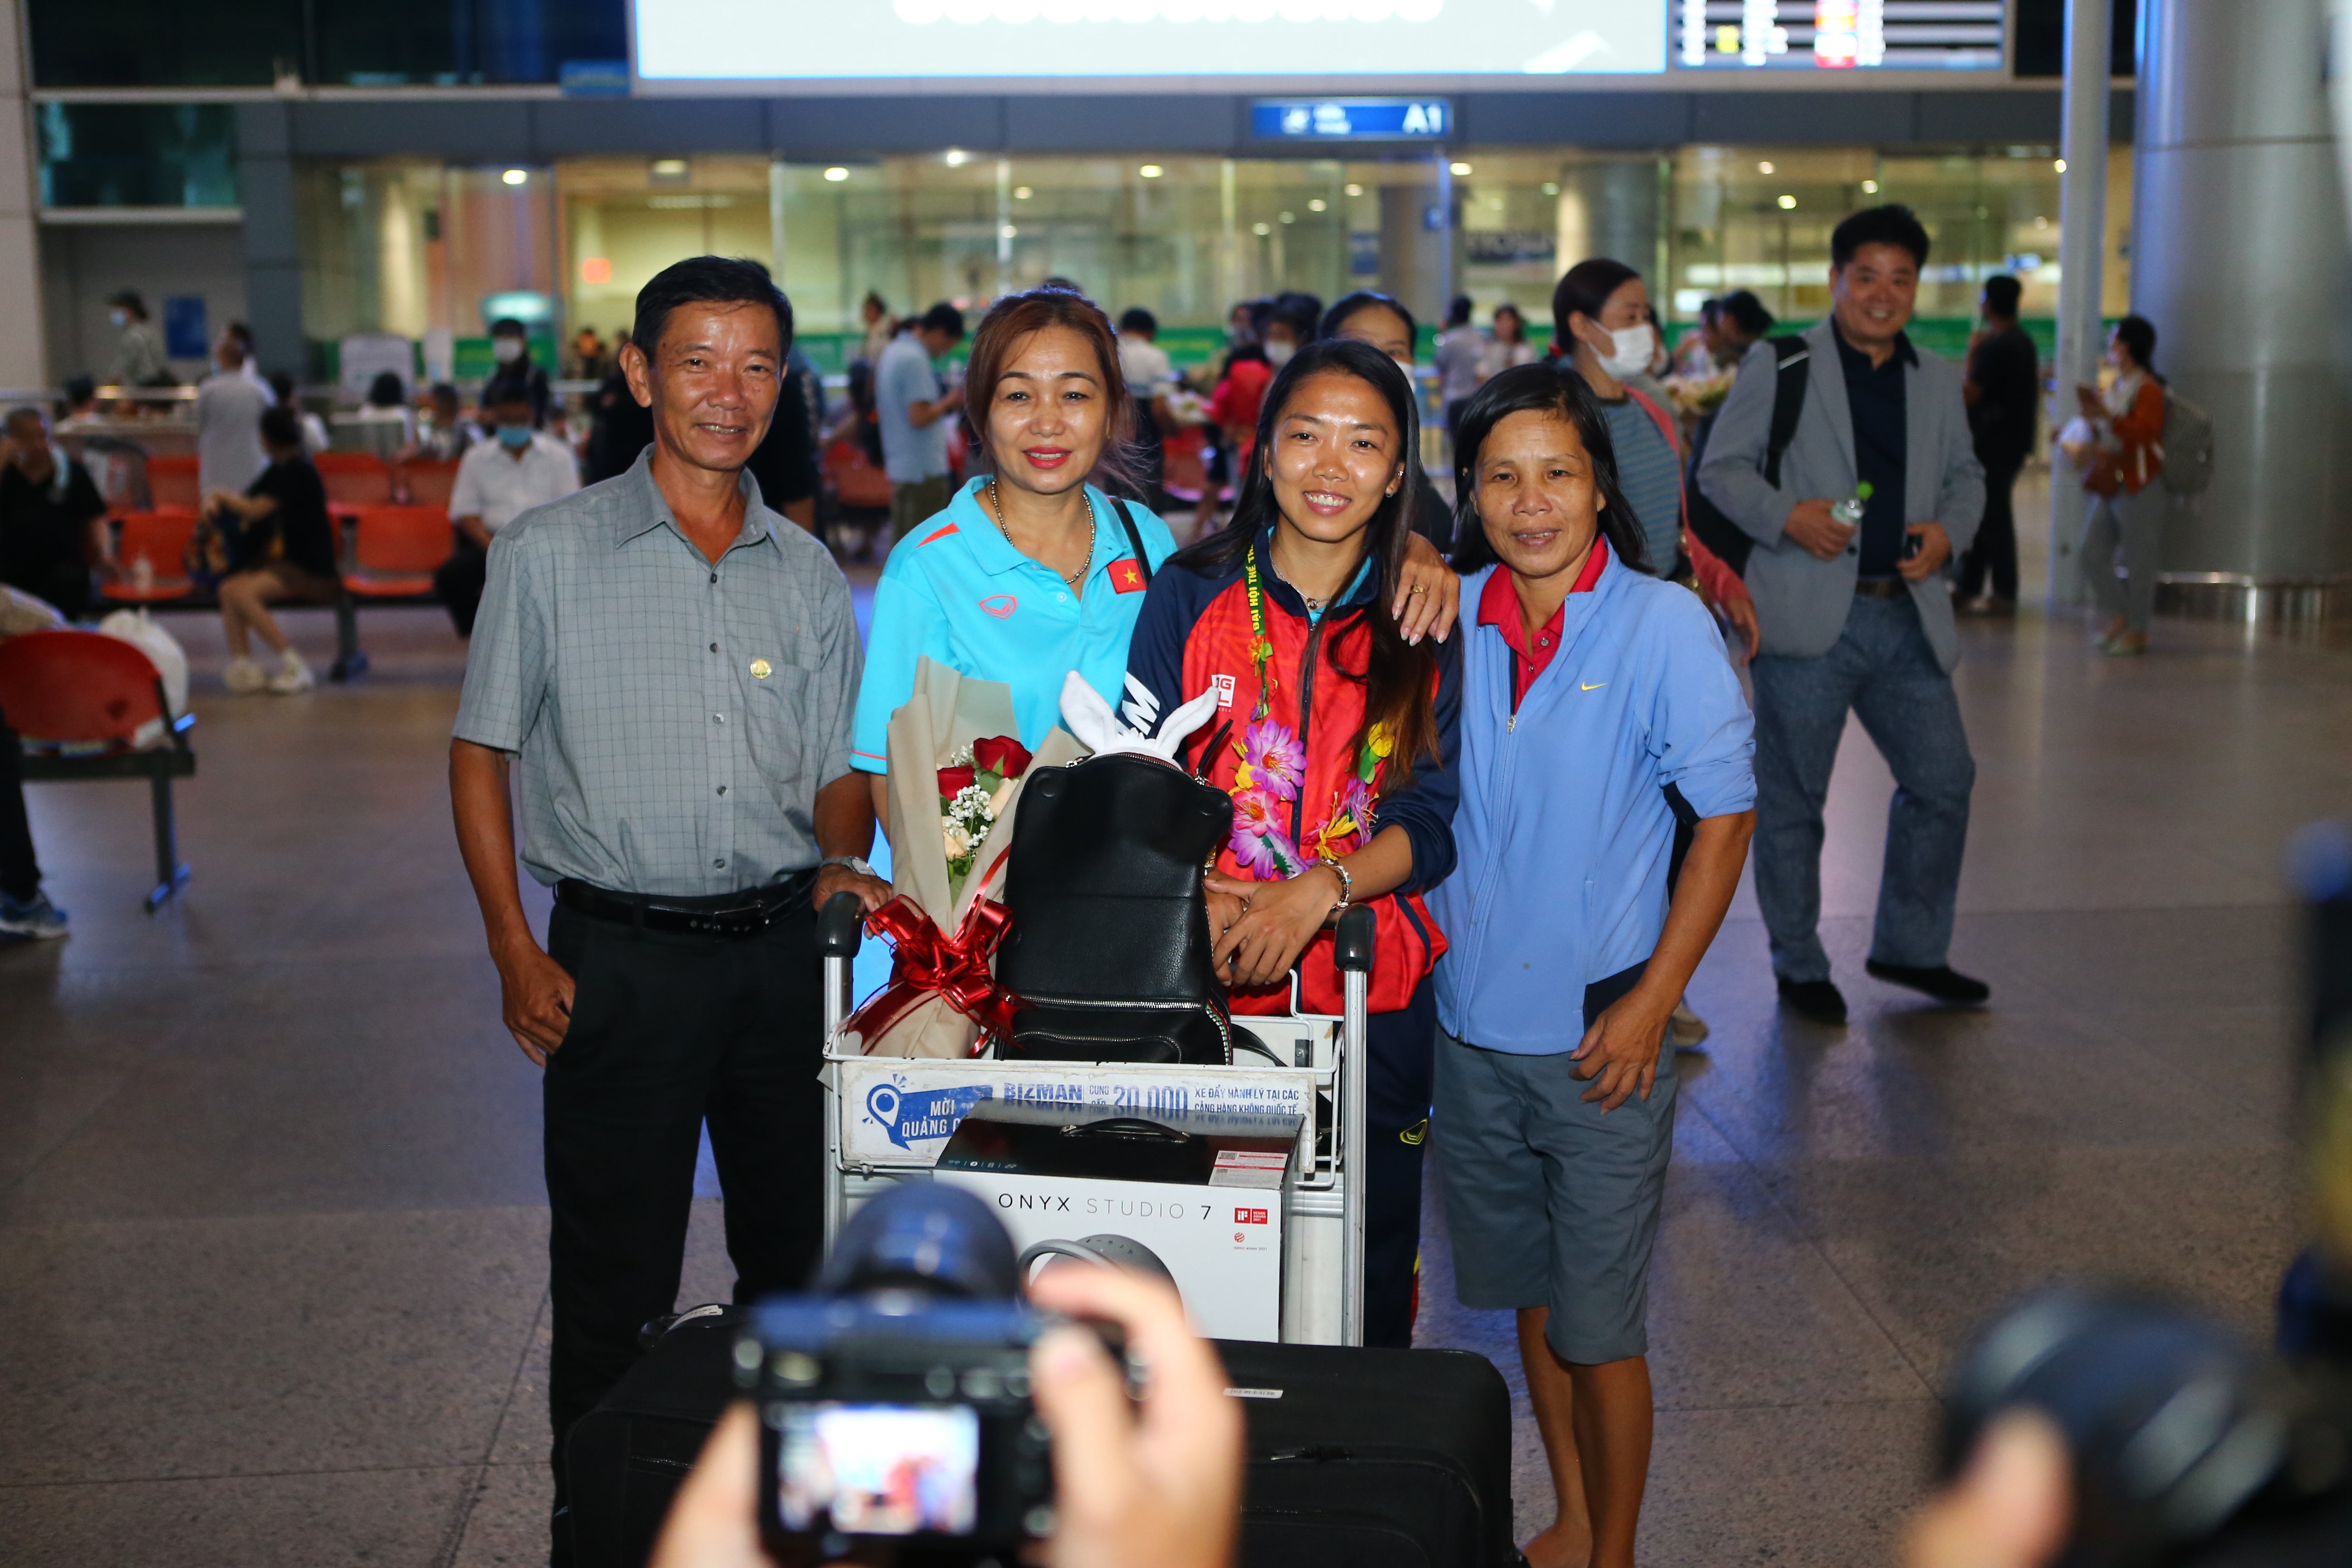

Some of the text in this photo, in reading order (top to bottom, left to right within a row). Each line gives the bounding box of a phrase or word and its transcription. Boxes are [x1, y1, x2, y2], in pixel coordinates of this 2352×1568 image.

[1402, 103, 1442, 134] A1
[1246, 564, 1257, 584] THỂ
[1248, 587, 1260, 607] HỘI
[1250, 609, 1261, 631] ĐẠI
[1089, 1085, 1109, 1095] CUNG
[1195, 1088, 1206, 1098] XE
[1228, 1087, 1251, 1099] HÀNH
[1254, 1088, 1264, 1099] LÝ
[1266, 1089, 1279, 1102] TẠI
[1282, 1088, 1298, 1100] CÁC
[930, 1098, 955, 1117] MỜI
[1195, 1101, 1215, 1112] CẢNG
[1217, 1102, 1237, 1112] HÀNG
[1239, 1103, 1264, 1113] KHÔNG
[1288, 1102, 1298, 1115] TẾ
[902, 1116, 947, 1137] QUẢNG
[998, 1194, 1211, 1220] ONYX STUDIO 7
